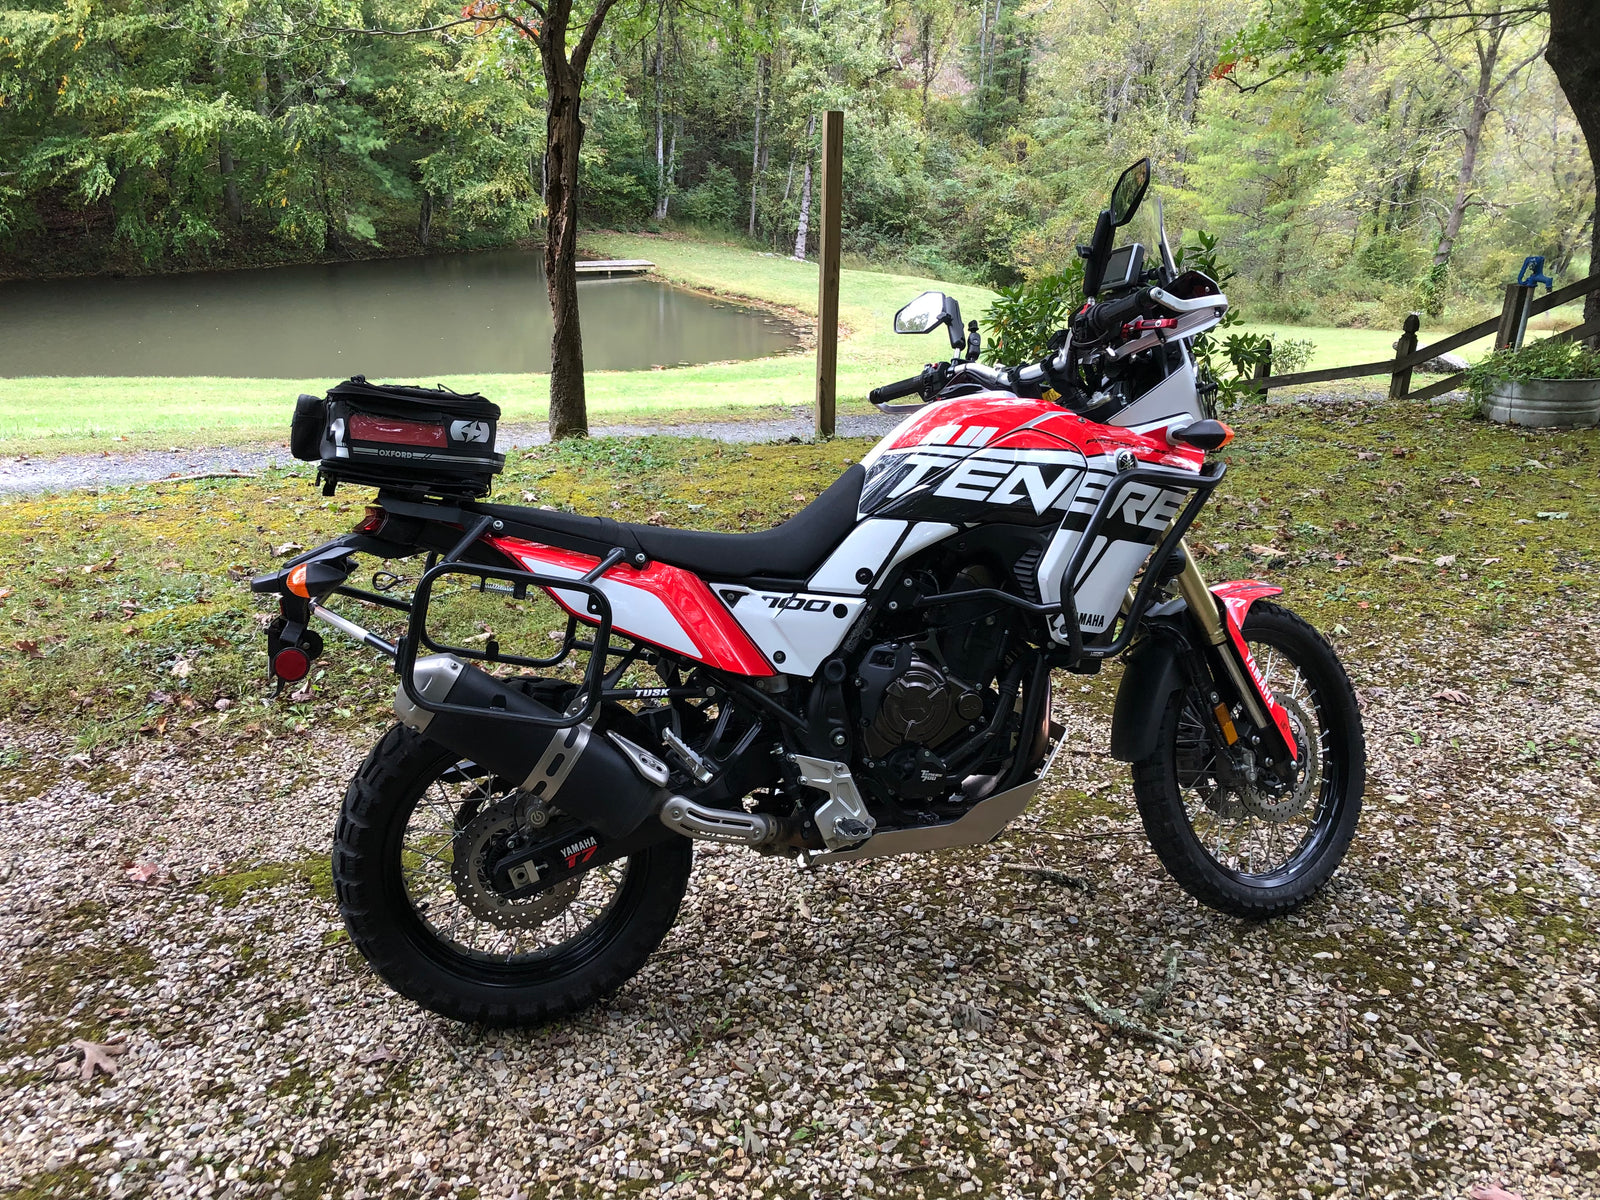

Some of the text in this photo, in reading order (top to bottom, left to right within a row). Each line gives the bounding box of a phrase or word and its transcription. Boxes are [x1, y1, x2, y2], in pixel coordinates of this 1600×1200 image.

[378, 449, 413, 459] OXFORD
[761, 595, 831, 612] 700
[1078, 612, 1105, 627] MAHA
[1246, 651, 1276, 709] YAMAHA
[634, 688, 671, 698] TUSK
[560, 836, 598, 858] YAMAHA
[565, 845, 598, 869] T7
